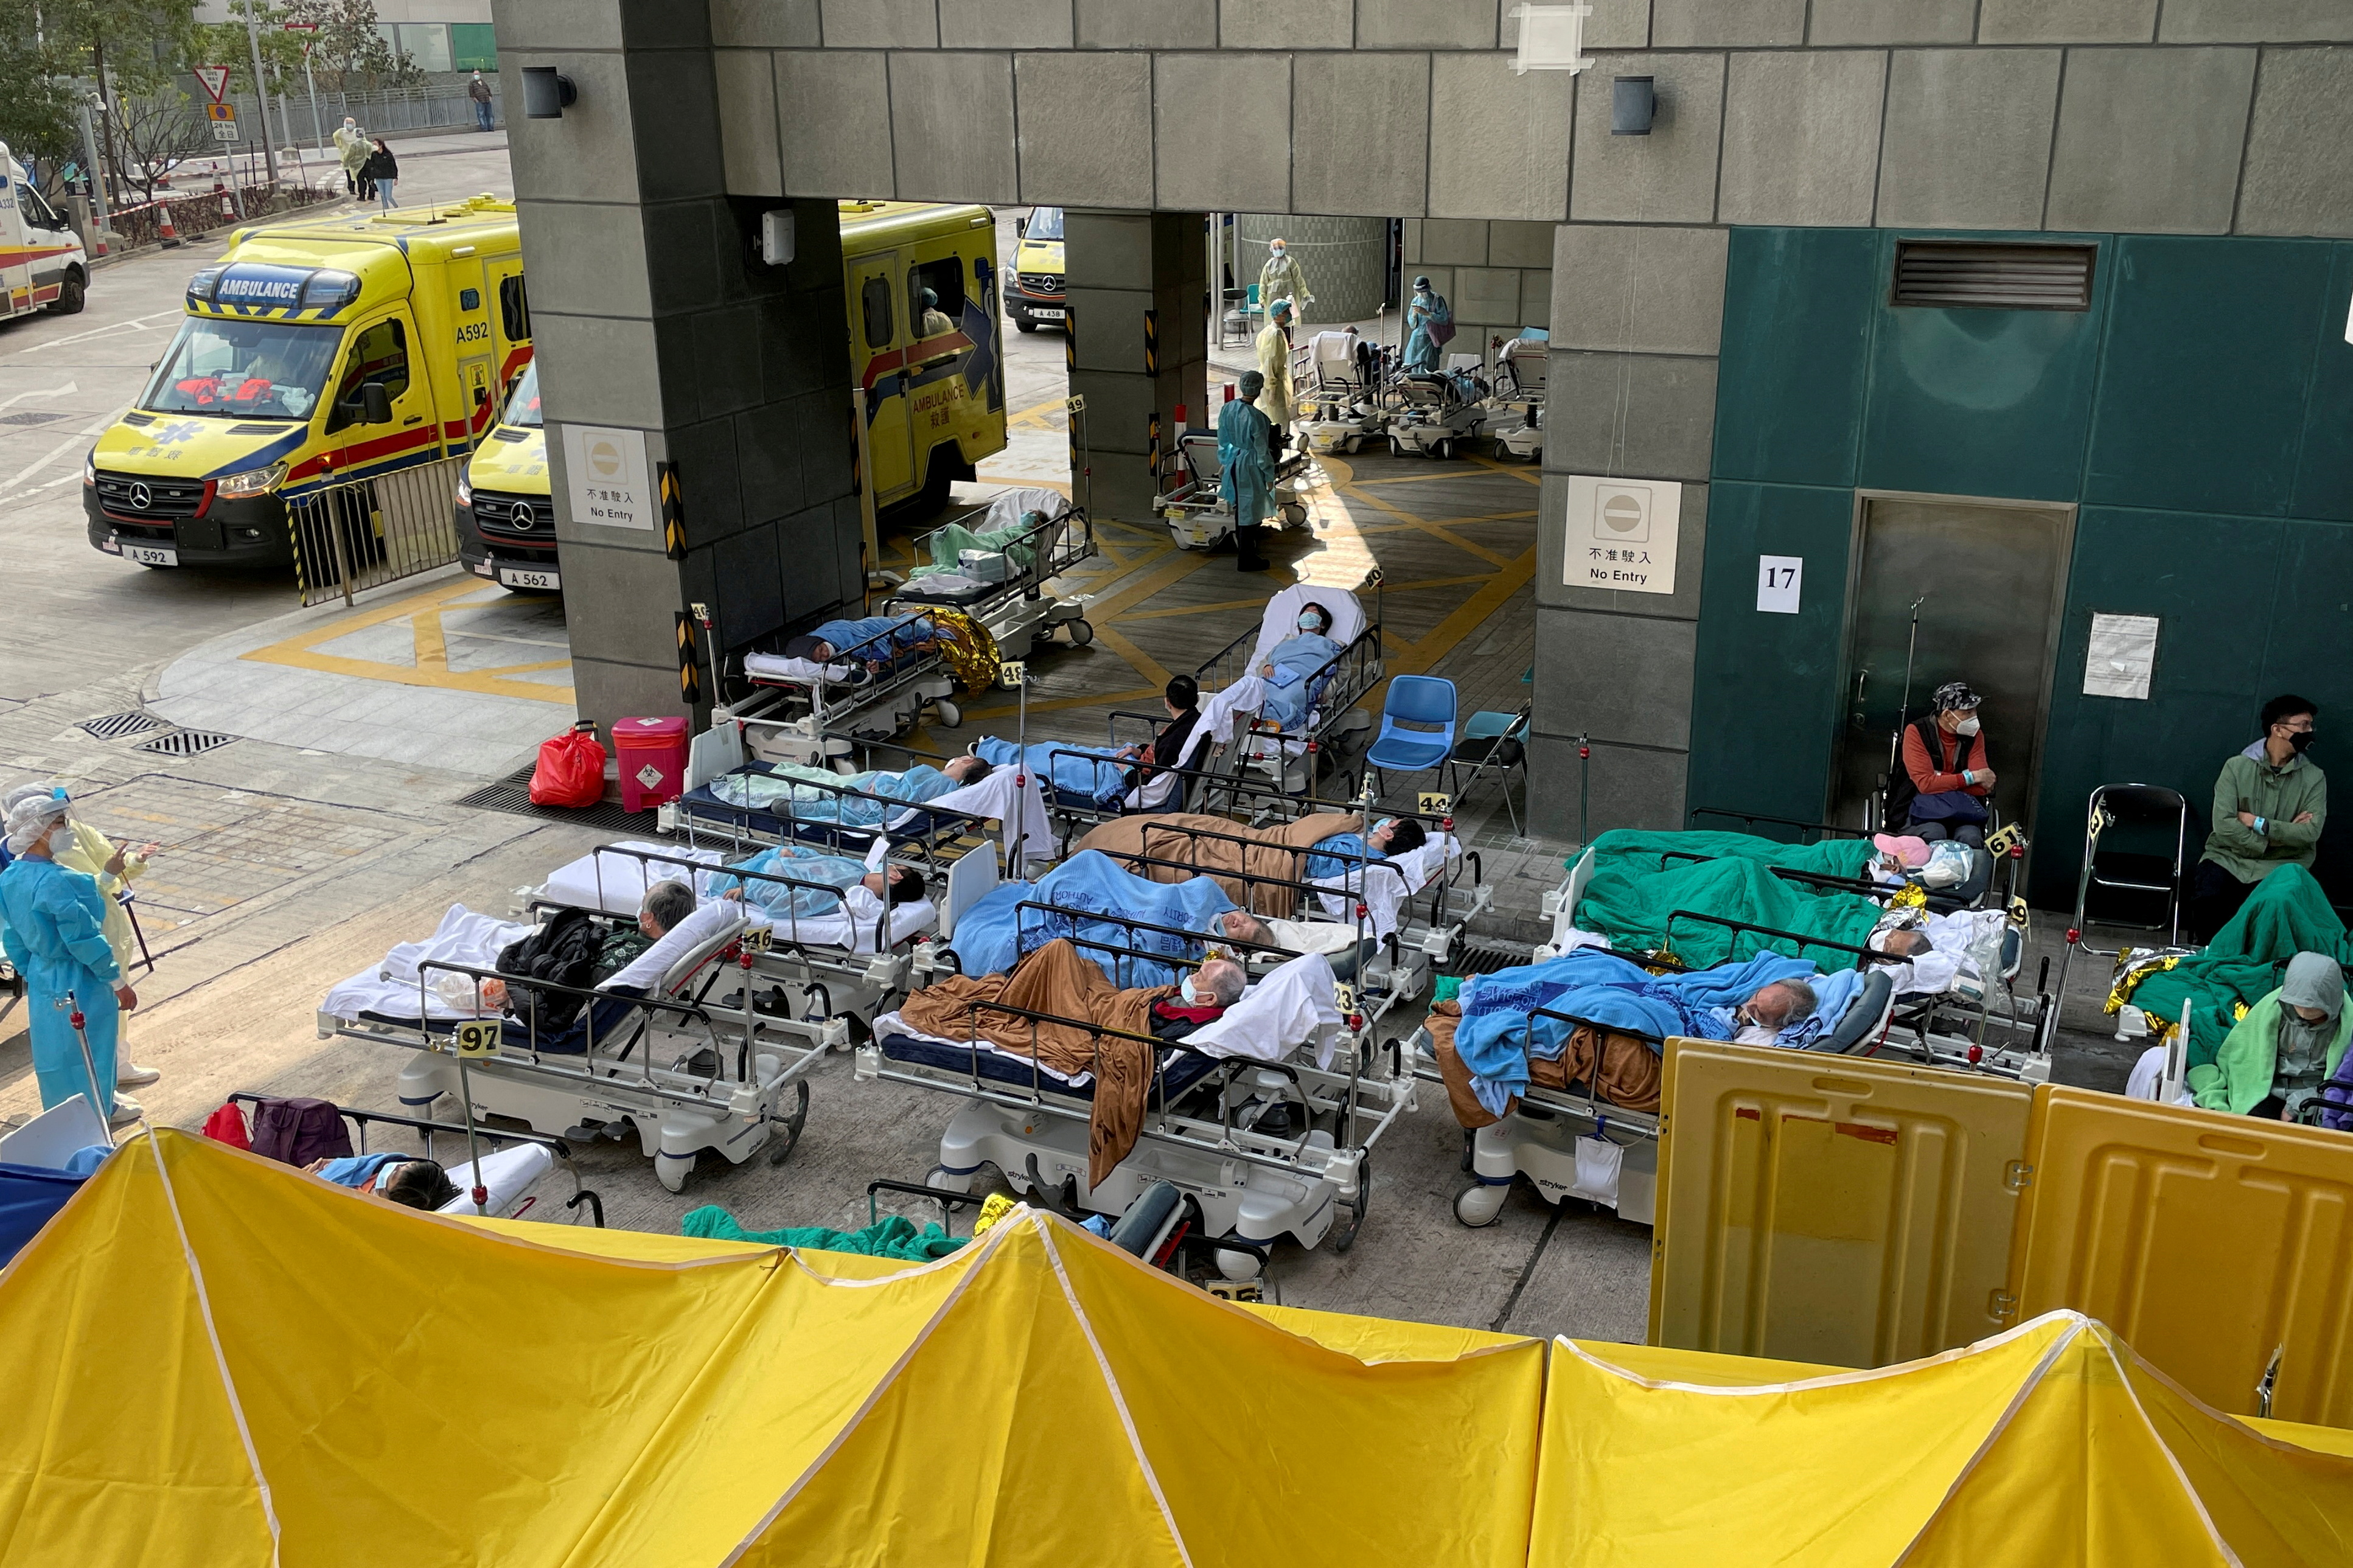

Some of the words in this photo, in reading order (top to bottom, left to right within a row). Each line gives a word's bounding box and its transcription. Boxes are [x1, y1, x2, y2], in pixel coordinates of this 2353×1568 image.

[219, 130, 234, 139] 全日
[219, 279, 299, 299] AMBULANCE
[456, 322, 488, 344] A592
[913, 384, 964, 415] AMBULANCE
[1068, 399, 1082, 411] 49
[930, 406, 950, 430] 救護
[587, 489, 633, 504] 不准駛入
[591, 507, 604, 517] No
[607, 509, 633, 522] Entry
[132, 549, 139, 560] A
[144, 551, 166, 563] 592
[1589, 548, 1651, 564] 不准駛入
[512, 573, 518, 584] A
[524, 574, 548, 586] 562
[1367, 570, 1381, 587] 80
[1591, 568, 1607, 579] No
[1613, 570, 1647, 585] Entry
[1766, 567, 1796, 589] 17
[1003, 666, 1022, 682] 48
[1420, 797, 1448, 813] 44
[1990, 830, 2018, 853] 61
[747, 929, 772, 949] 46
[1334, 988, 1353, 1011] 23
[461, 1025, 498, 1051] 97
